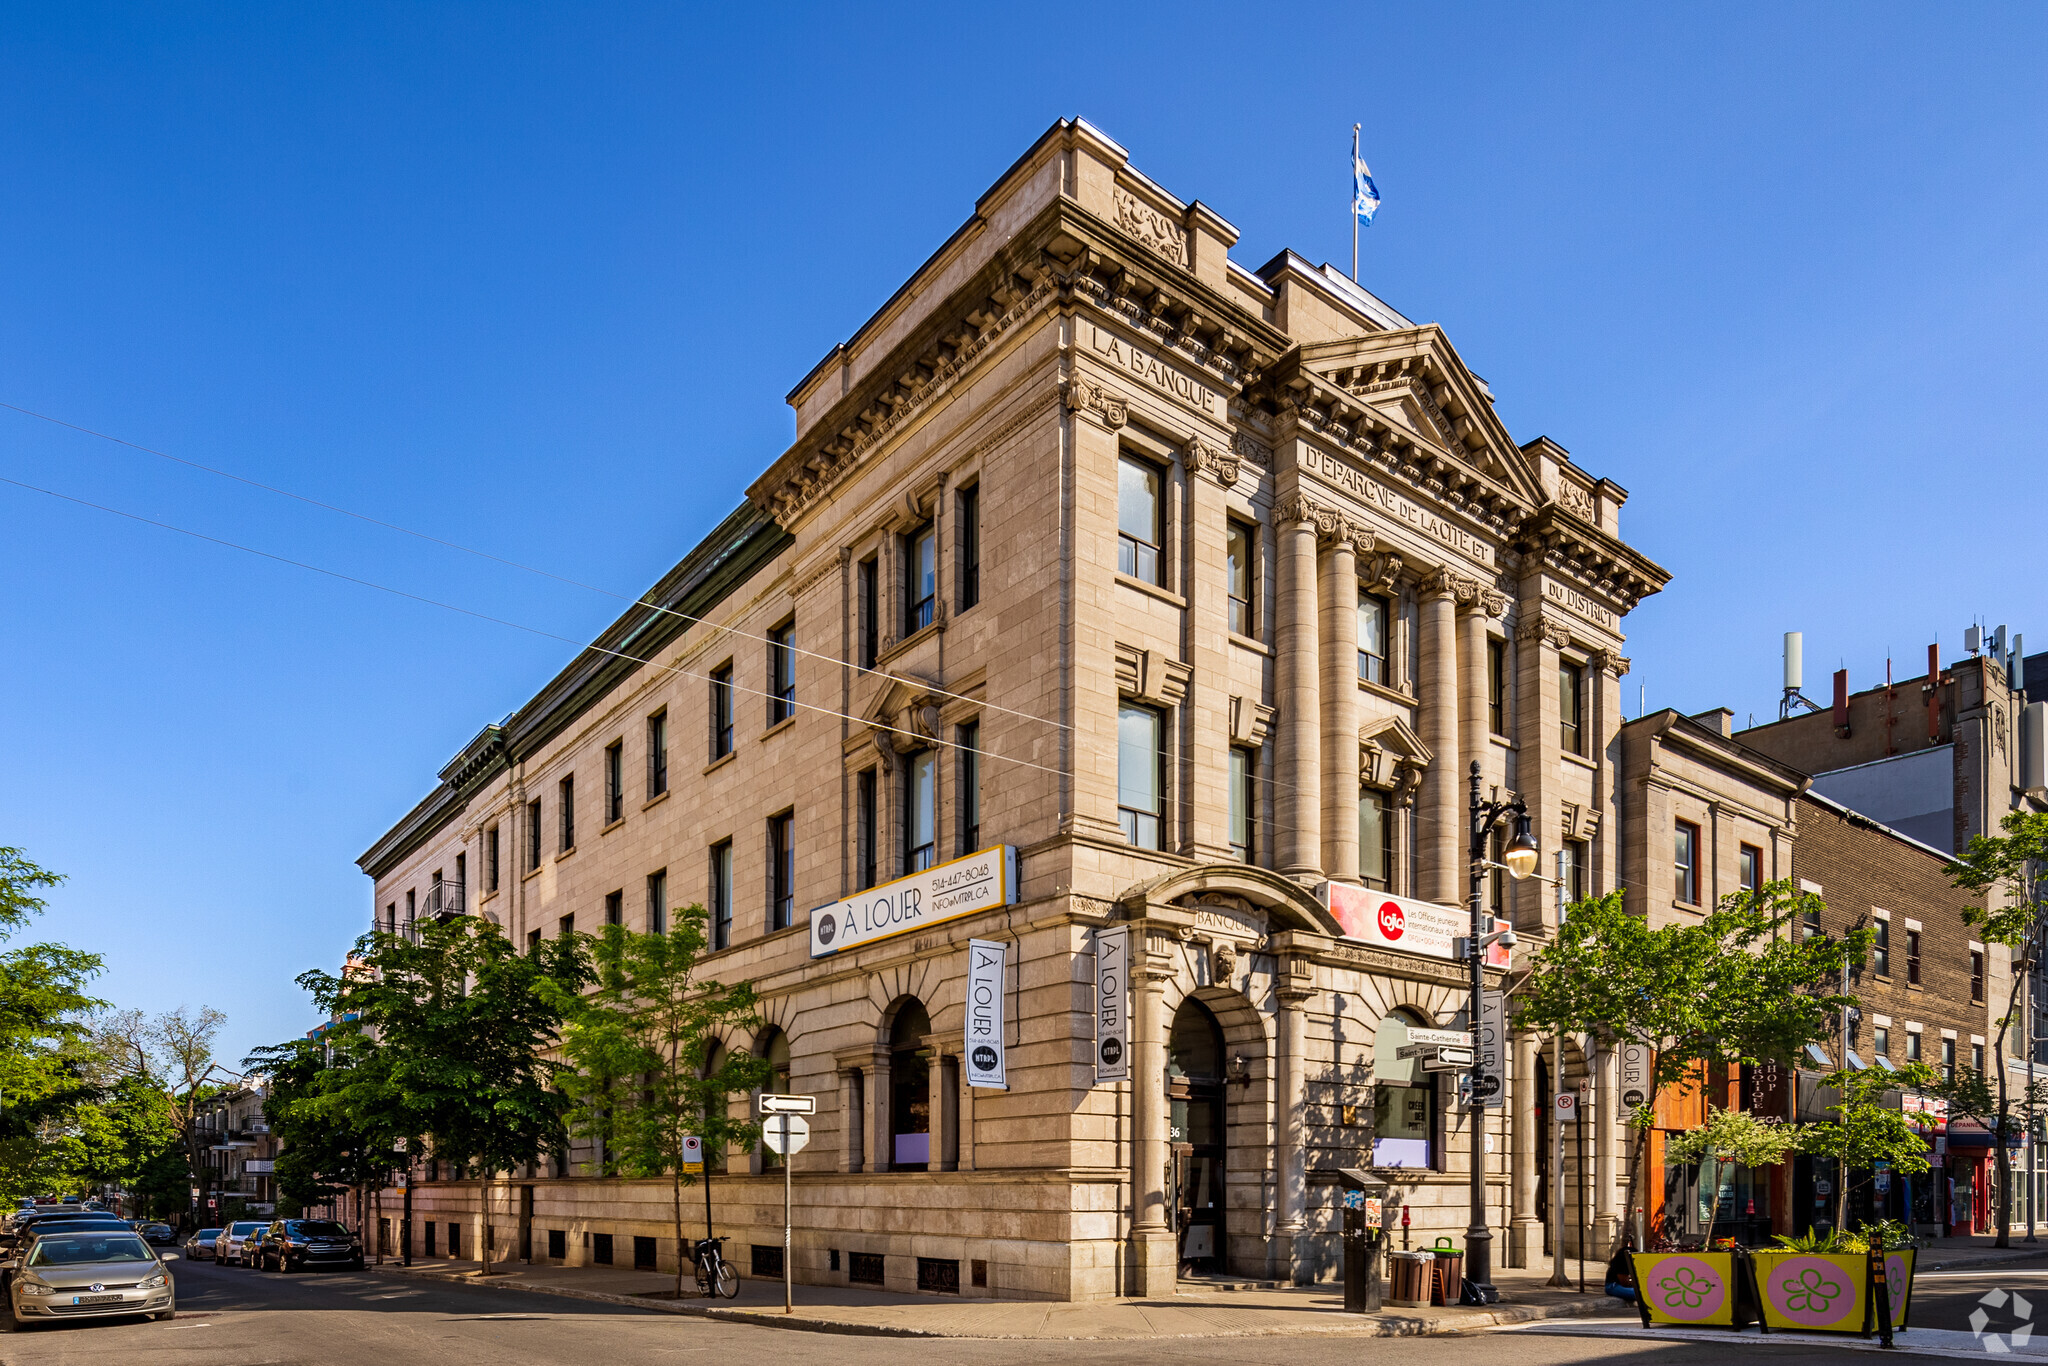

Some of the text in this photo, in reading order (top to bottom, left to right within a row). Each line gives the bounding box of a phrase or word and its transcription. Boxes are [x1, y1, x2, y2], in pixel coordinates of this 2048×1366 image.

[1130, 347, 1215, 414] BANQUE
[1306, 446, 1488, 560] D'EPARGNE DE LA CITE ET
[1549, 582, 1614, 628] DU DISTRICT
[931, 864, 990, 892] 514-447-8048
[841, 903, 858, 940] À
[865, 887, 922, 932] LOUER
[1197, 911, 1252, 933] BANQUE
[1408, 909, 1459, 928] Les Offices jeunesse
[973, 951, 998, 1036] À LOUER
[1101, 941, 1121, 1028] À LOUER
[1399, 1046, 1437, 1058] Saint-Timo
[1410, 1032, 1461, 1043] Sainte-Catherine
[1483, 1081, 1498, 1089] TRPL
[1767, 1057, 1777, 1092] SHOP
